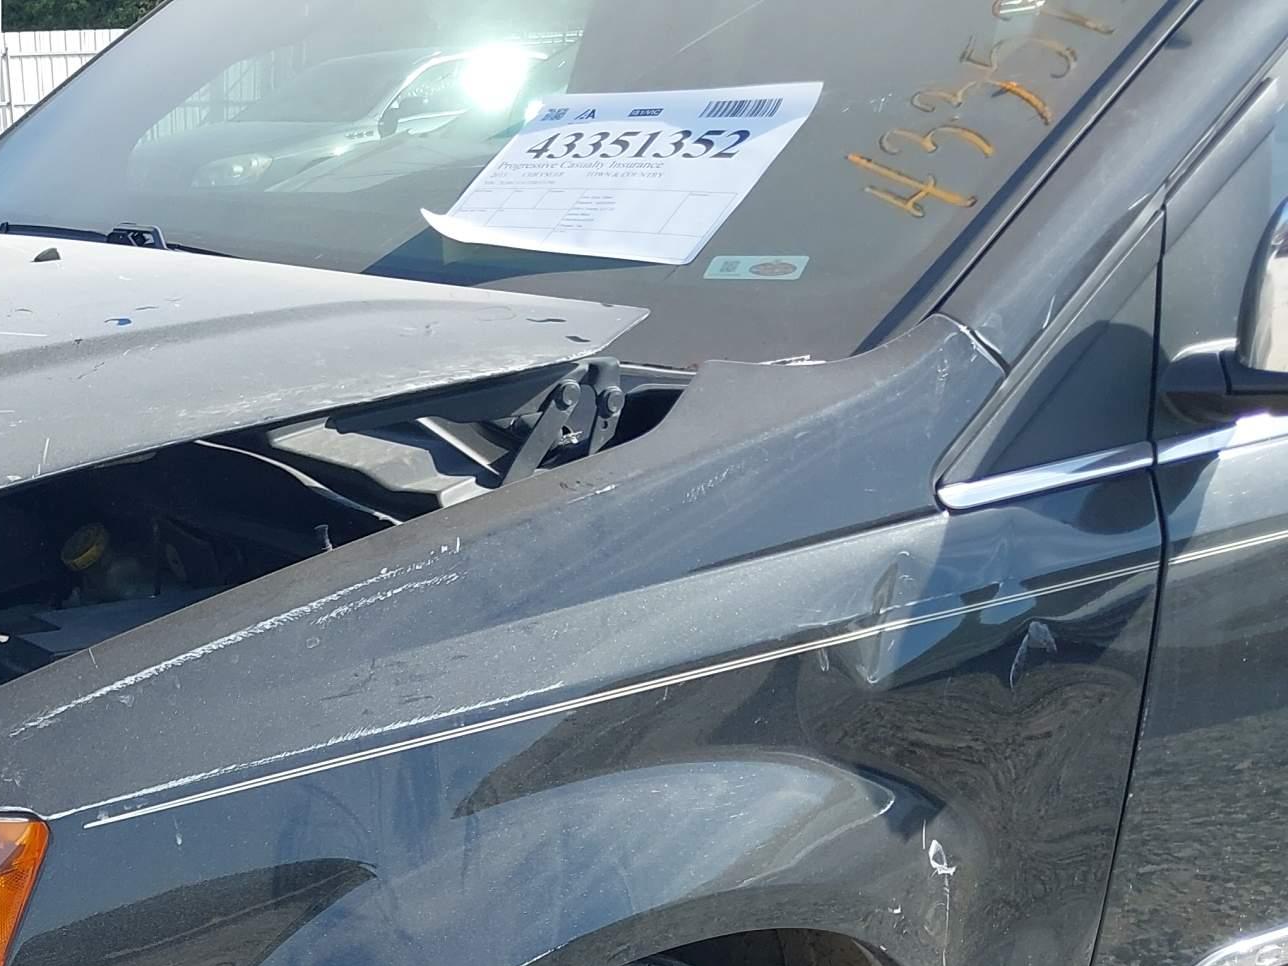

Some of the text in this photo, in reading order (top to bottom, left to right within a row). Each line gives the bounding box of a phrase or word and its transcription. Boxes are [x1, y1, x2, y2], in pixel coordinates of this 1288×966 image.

[527, 129, 752, 160] 43351352
[498, 160, 665, 171] Progressive Casualty Insurance
